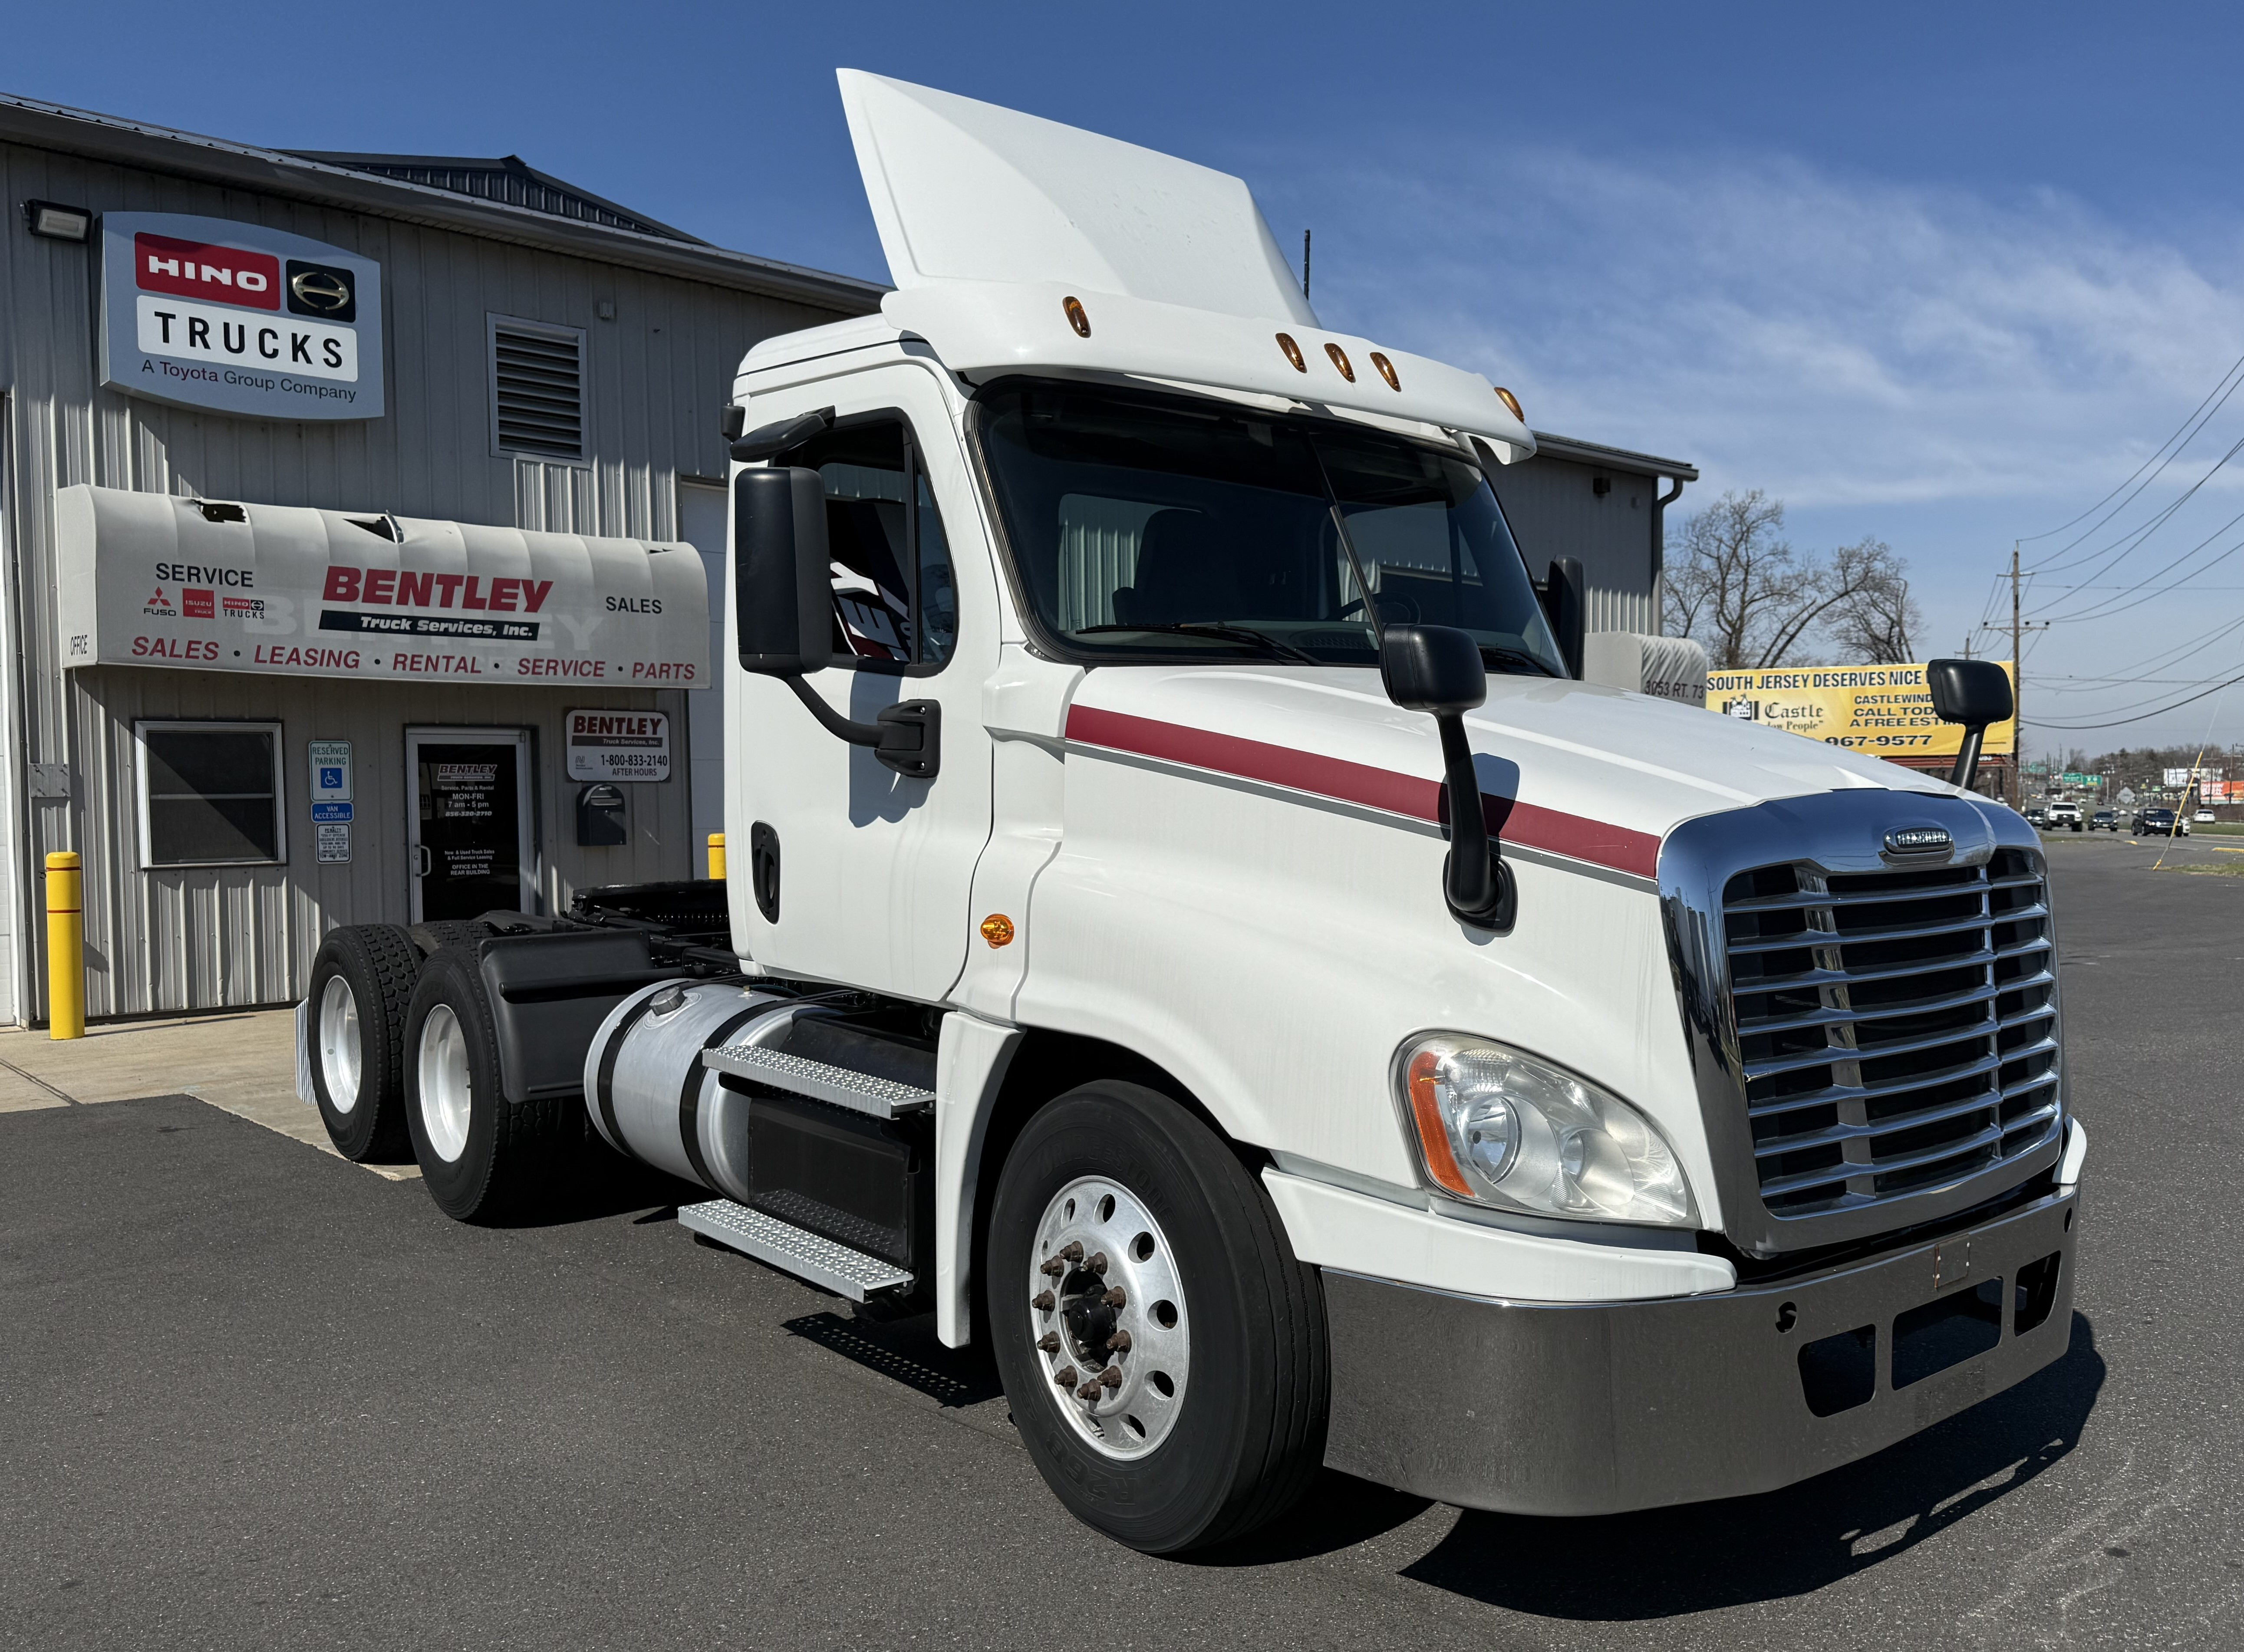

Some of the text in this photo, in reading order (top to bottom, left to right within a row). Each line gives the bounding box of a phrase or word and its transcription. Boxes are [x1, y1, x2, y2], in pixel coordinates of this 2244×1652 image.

[148, 255, 267, 292] HINO
[154, 311, 343, 369] TRUCKS
[142, 359, 356, 403] A Toyota Group Company
[156, 563, 254, 588] SERVICE
[322, 565, 554, 614] BENTLEY
[144, 608, 176, 616] FUSO
[223, 609, 264, 619] TRUCKS
[606, 596, 662, 615] SALES
[360, 616, 533, 637] Truck Services, Inc.
[70, 634, 87, 656] OFFICE
[132, 635, 696, 681] SALES LEASING RENTAL SERVICE PARTS
[1644, 680, 1704, 699] 3053 RT. 73
[1707, 675, 1753, 691] SOUTH
[1756, 674, 1809, 689] JERSEY
[1813, 671, 1885, 688] DESERVES
[1889, 671, 1922, 685] NICE
[1855, 694, 1932, 704] CASTLEWIND
[1765, 702, 1824, 718] Castle
[1853, 707, 1935, 717] CALL TOD
[573, 715, 663, 736] BENTLEY
[1849, 719, 1861, 727] A
[1865, 718, 1906, 727] FREE
[312, 747, 348, 755] RESERVED
[601, 754, 668, 767] 1-800-833-2140
[315, 757, 346, 766] PARKING
[439, 764, 497, 774] BENTLEY
[612, 768, 657, 777] AFTER HOURS
